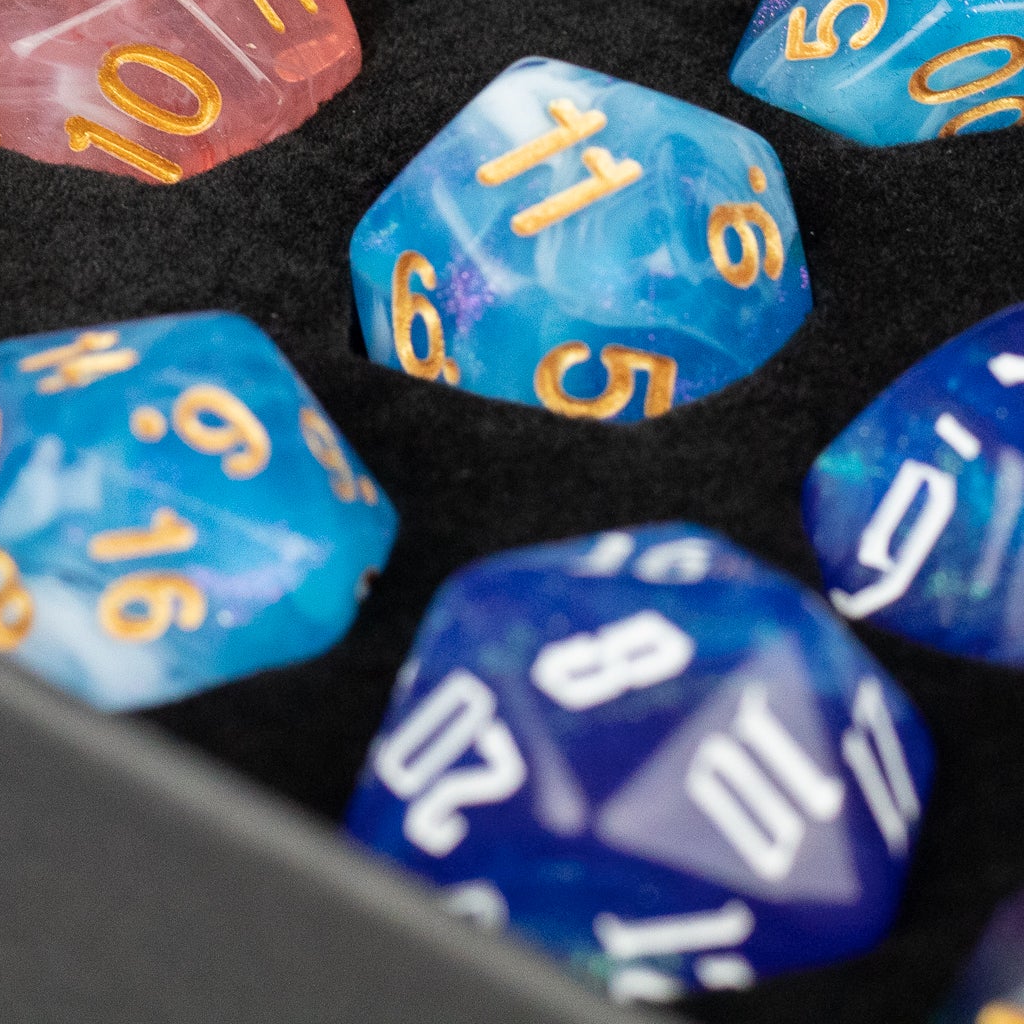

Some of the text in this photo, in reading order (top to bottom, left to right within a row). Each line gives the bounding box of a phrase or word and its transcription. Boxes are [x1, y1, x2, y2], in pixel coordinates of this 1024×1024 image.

[65, 43, 223, 185] 10
[476, 97, 644, 239] 11
[533, 340, 678, 420] 5
[86, 506, 208, 643] 16
[531, 608, 698, 711] 8
[377, 668, 526, 859] 20
[687, 683, 846, 880] 10
